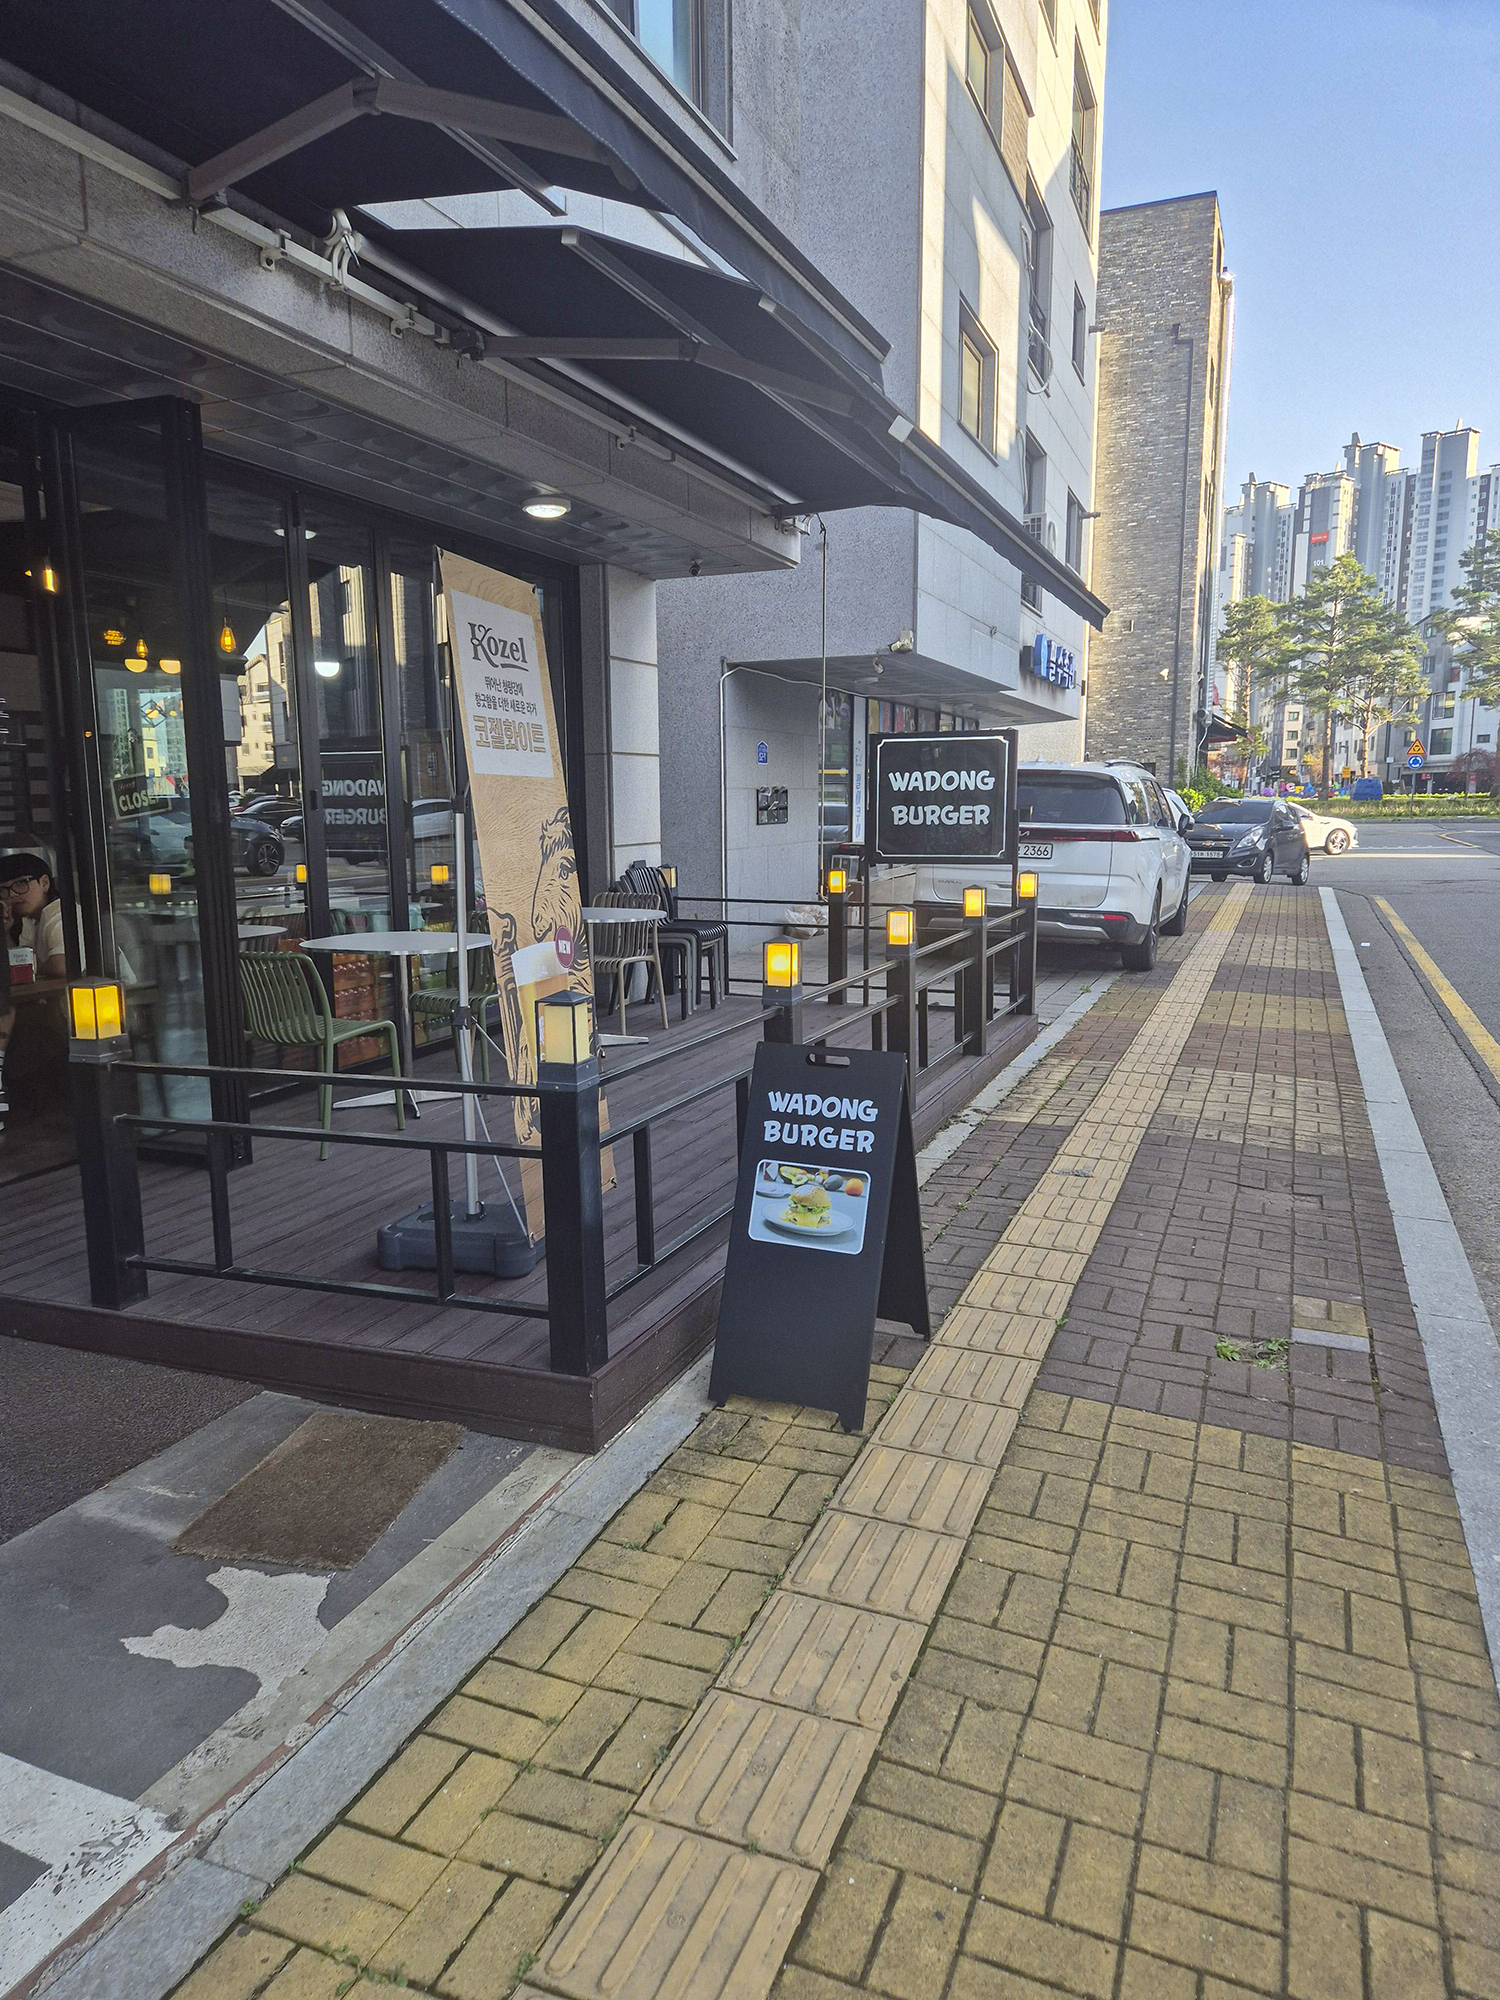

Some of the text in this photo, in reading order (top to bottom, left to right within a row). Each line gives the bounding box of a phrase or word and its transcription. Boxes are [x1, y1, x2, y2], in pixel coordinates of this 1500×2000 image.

[1313, 559, 1324, 567] 101
[467, 622, 529, 672] Kozel
[484, 675, 524, 696] 뛰어난 청량감에
[474, 692, 538, 716] 향긋함을 더한 새로운 라거
[473, 715, 546, 753] 코젤화이트
[888, 770, 995, 792] WADONG
[891, 804, 991, 826] BURGER
[1023, 844, 1049, 857] 2366
[767, 1090, 878, 1122] WADONG
[763, 1120, 875, 1153] BURGER
